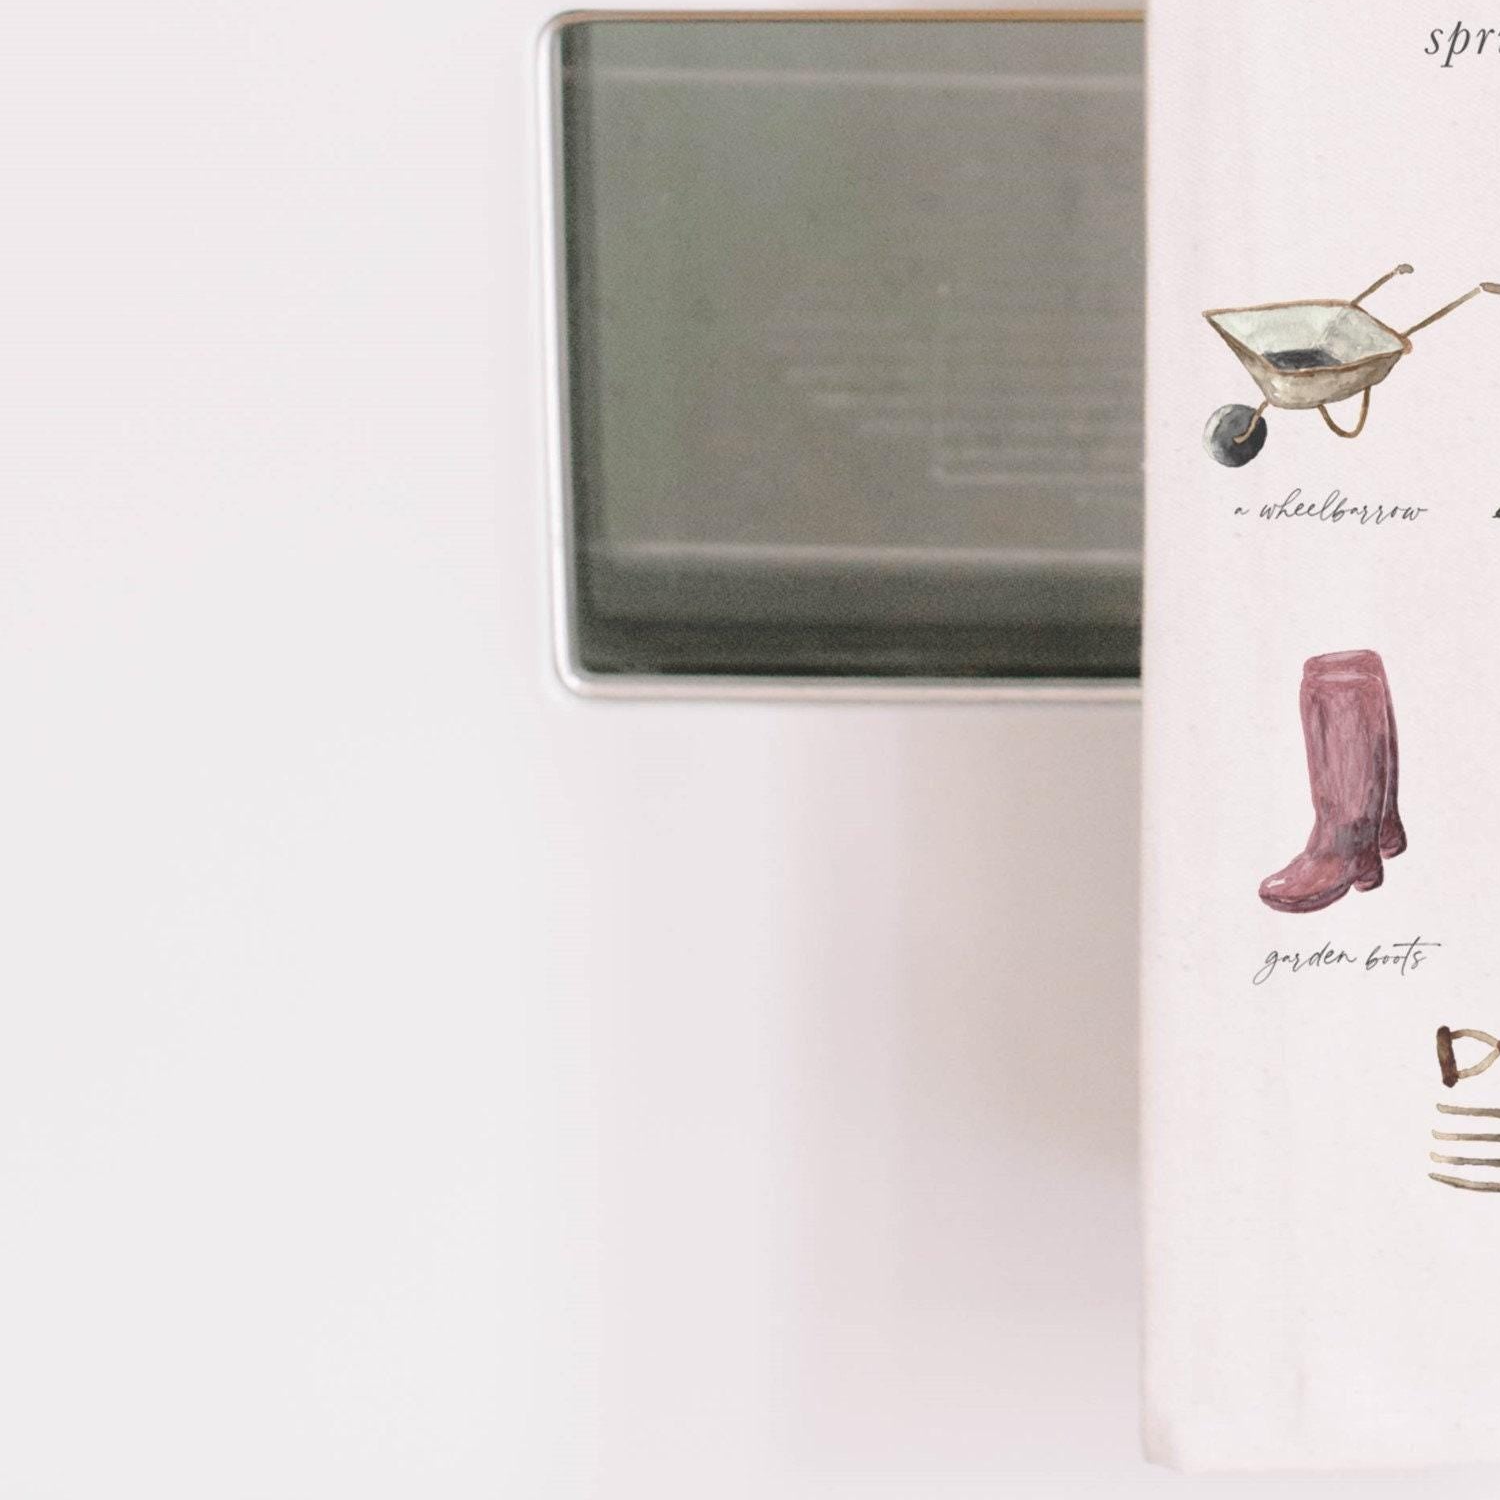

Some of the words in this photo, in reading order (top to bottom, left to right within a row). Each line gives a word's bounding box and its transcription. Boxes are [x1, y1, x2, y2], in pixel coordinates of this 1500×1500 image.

[1233, 506, 1250, 516] a
[1259, 487, 1429, 525] wheelbarrow
[1252, 941, 1358, 986] garden
[1364, 936, 1442, 977] boots
